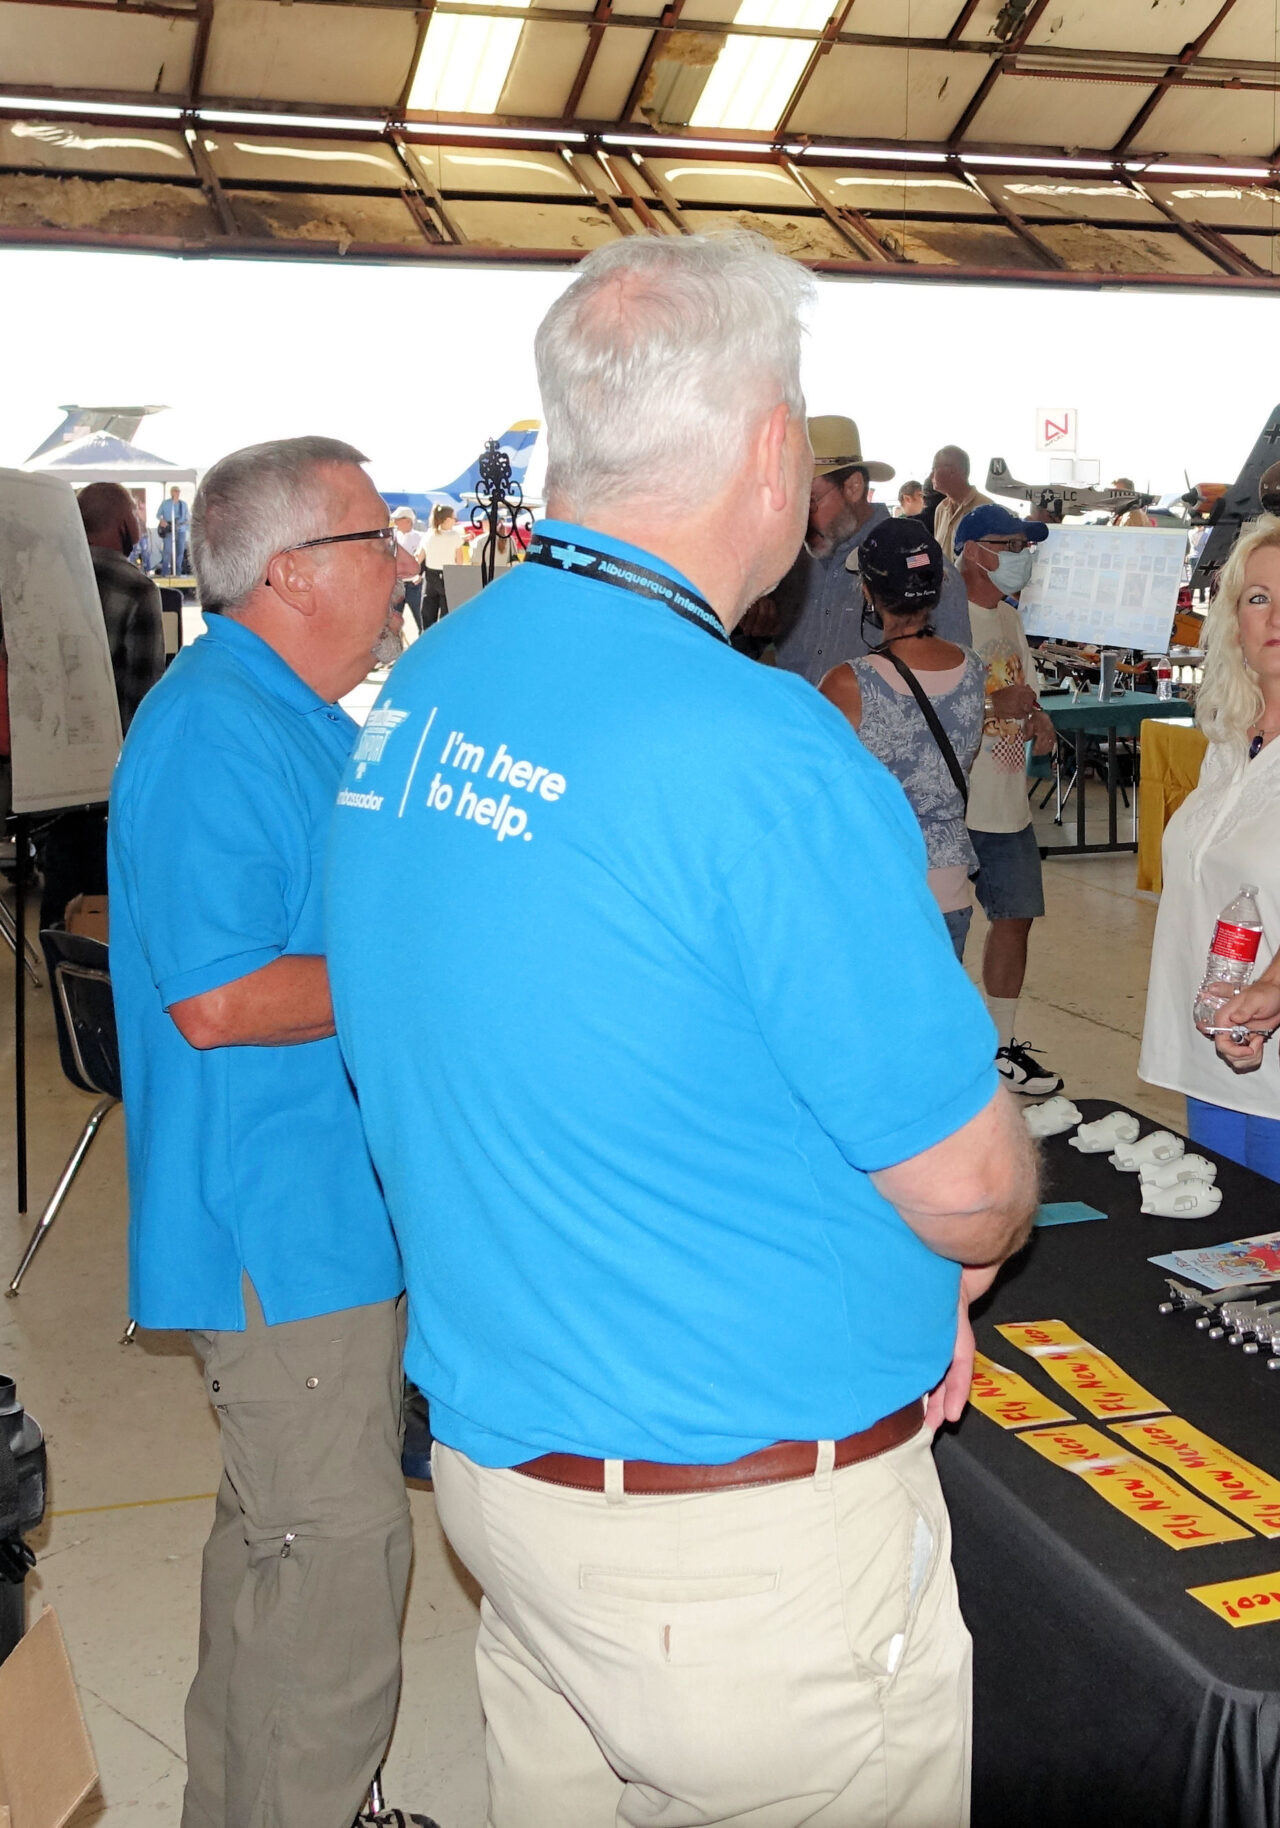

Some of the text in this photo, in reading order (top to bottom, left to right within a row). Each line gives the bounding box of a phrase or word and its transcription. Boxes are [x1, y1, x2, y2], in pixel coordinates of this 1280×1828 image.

[993, 460, 1003, 474] N
[1025, 489, 1078, 501] N LC
[598, 560, 729, 640] Albuquerque Internation
[440, 731, 485, 773] I'm
[487, 744, 567, 811] here
[336, 787, 384, 811] mbassador
[426, 772, 533, 842] to help.
[1067, 1362, 1108, 1389] New
[995, 1401, 1041, 1421] Fly
[1093, 1391, 1138, 1412] Fly
[1121, 1422, 1216, 1469] Mexico!
[1033, 1431, 1216, 1540] Fly New Mxico!
[1205, 1469, 1261, 1502] New
